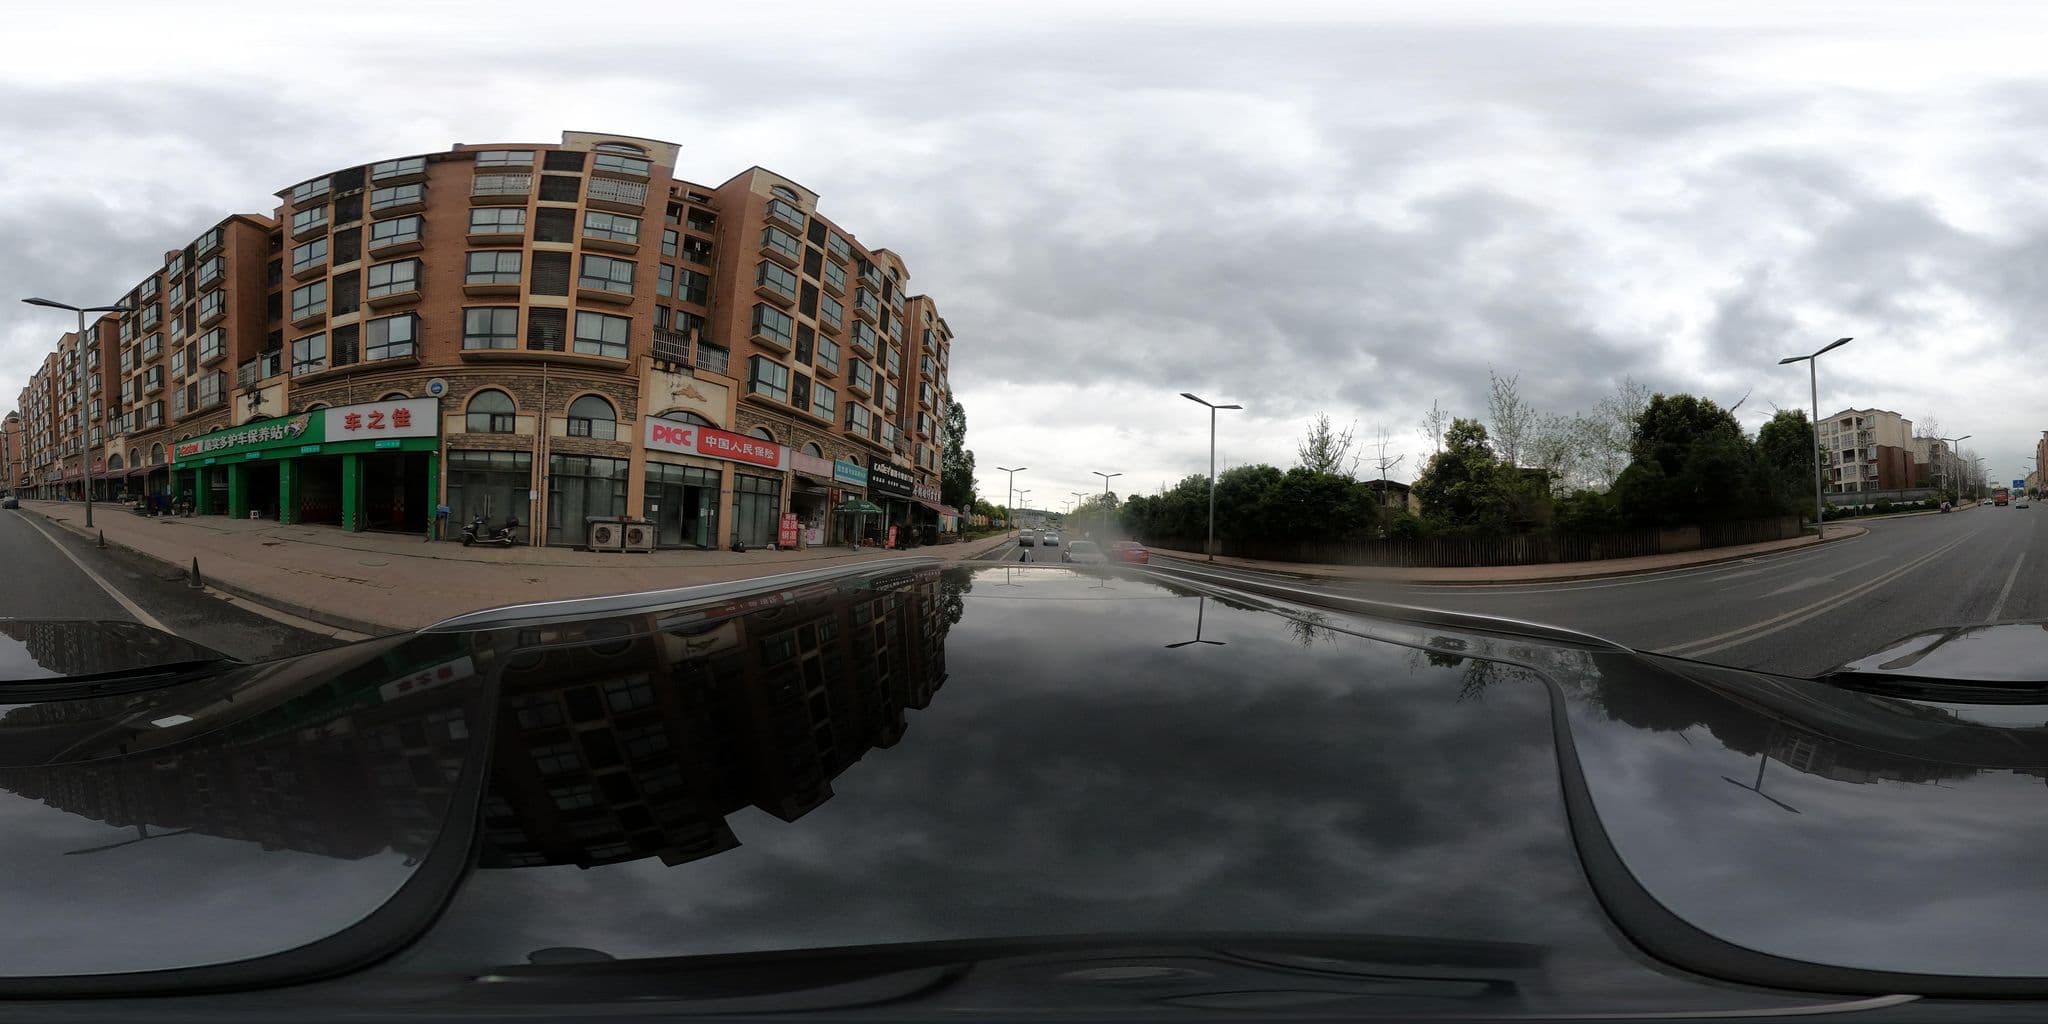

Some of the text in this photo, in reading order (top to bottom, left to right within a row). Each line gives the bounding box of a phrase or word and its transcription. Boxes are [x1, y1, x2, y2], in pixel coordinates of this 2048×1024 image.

[344, 408, 411, 431] 车之佳
[653, 424, 692, 447] PICC
[705, 435, 775, 459] 中国人民保险
